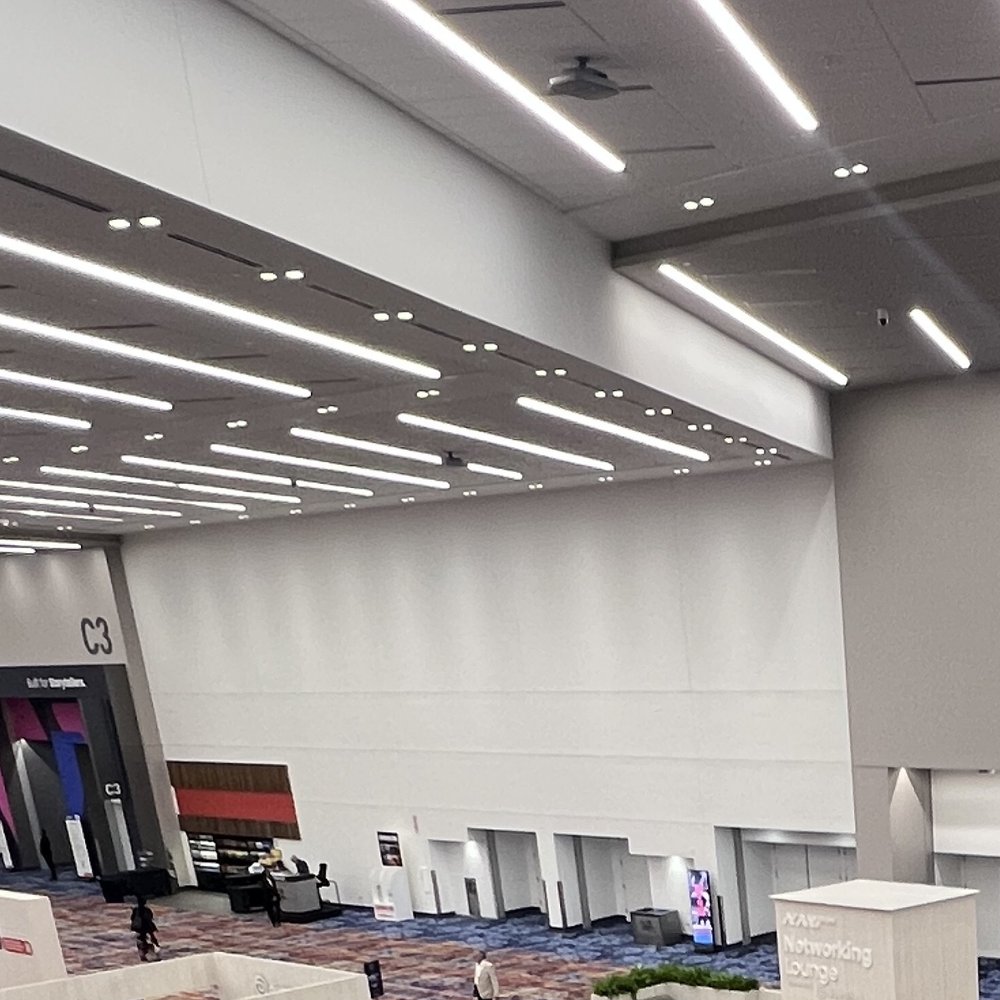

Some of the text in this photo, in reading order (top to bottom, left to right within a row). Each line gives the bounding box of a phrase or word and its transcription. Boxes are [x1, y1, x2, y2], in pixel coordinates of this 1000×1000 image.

[81, 617, 112, 655] C3
[783, 935, 873, 968] Networking
[785, 958, 839, 985] Lounge
